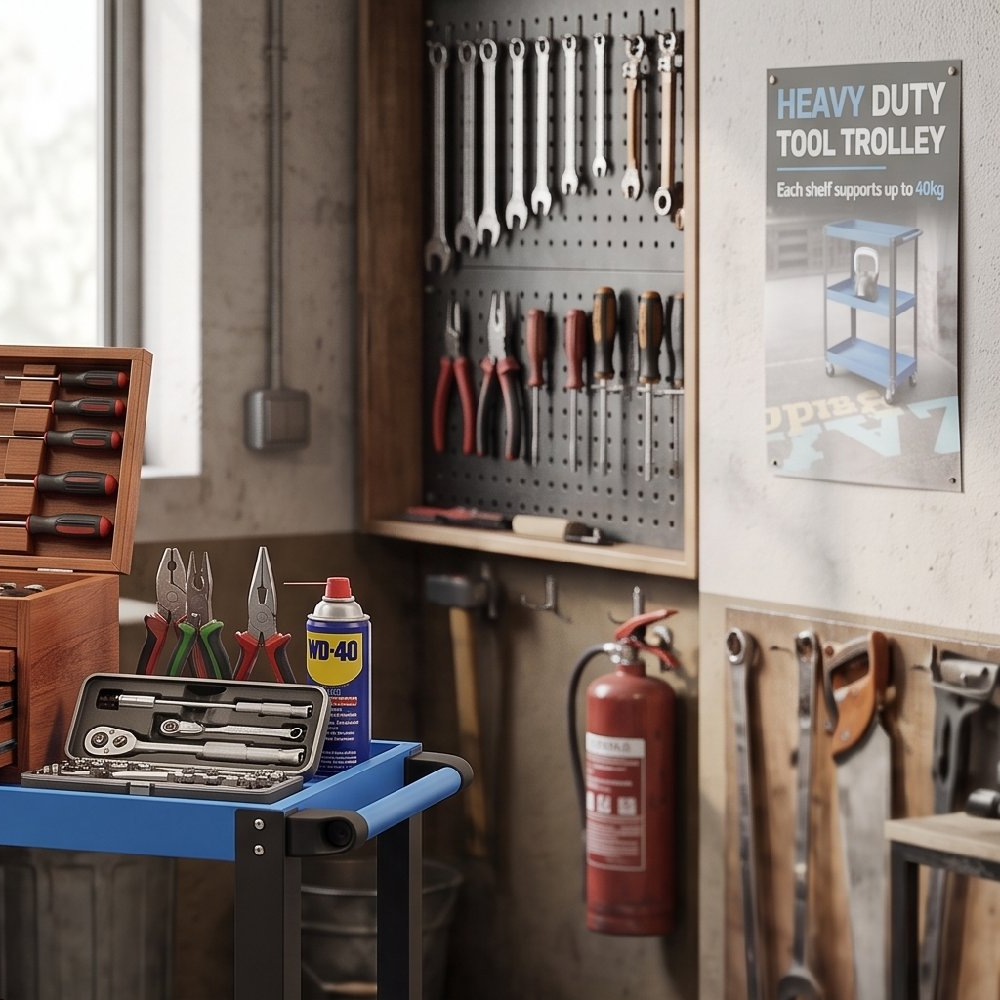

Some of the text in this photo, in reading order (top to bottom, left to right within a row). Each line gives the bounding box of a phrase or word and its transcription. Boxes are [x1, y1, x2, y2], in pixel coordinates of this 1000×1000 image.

[777, 82, 946, 119] HEAVY DUTY
[776, 126, 946, 157] TOOL TROLLEY
[777, 181, 945, 200] Each shelf supports up to 40kg
[308, 639, 357, 661] WD-40
